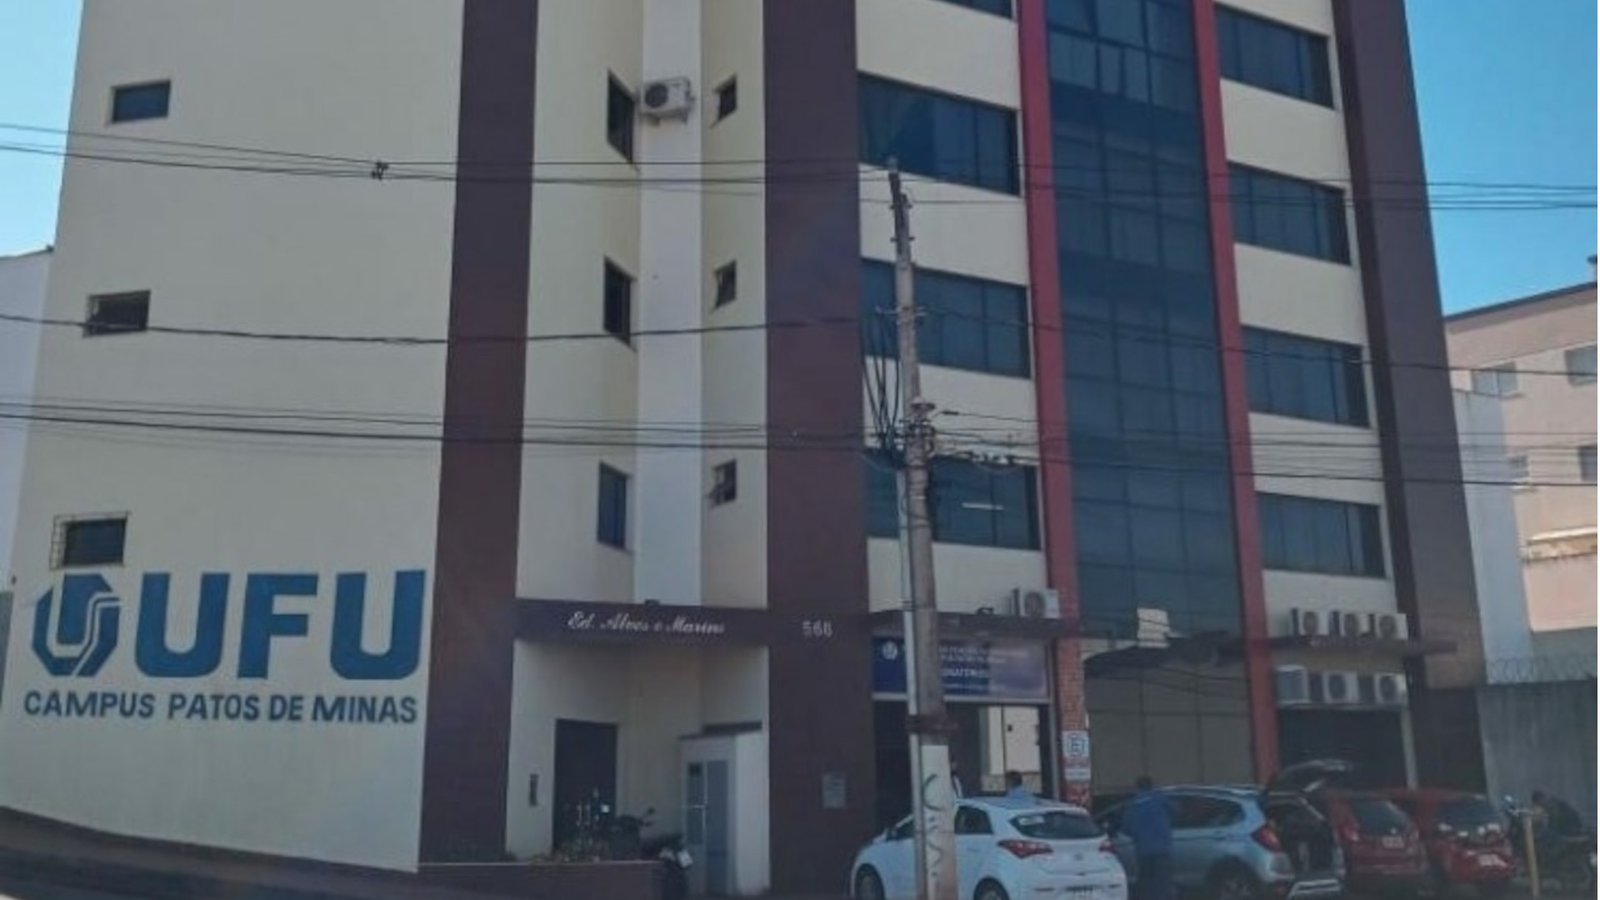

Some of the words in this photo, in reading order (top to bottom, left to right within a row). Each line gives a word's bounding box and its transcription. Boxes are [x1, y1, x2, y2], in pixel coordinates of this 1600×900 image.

[135, 570, 427, 680] UFU
[23, 690, 156, 719] CAMPUS
[167, 693, 261, 722] PATOS
[268, 694, 303, 722] DE
[311, 694, 418, 724] MINAS
